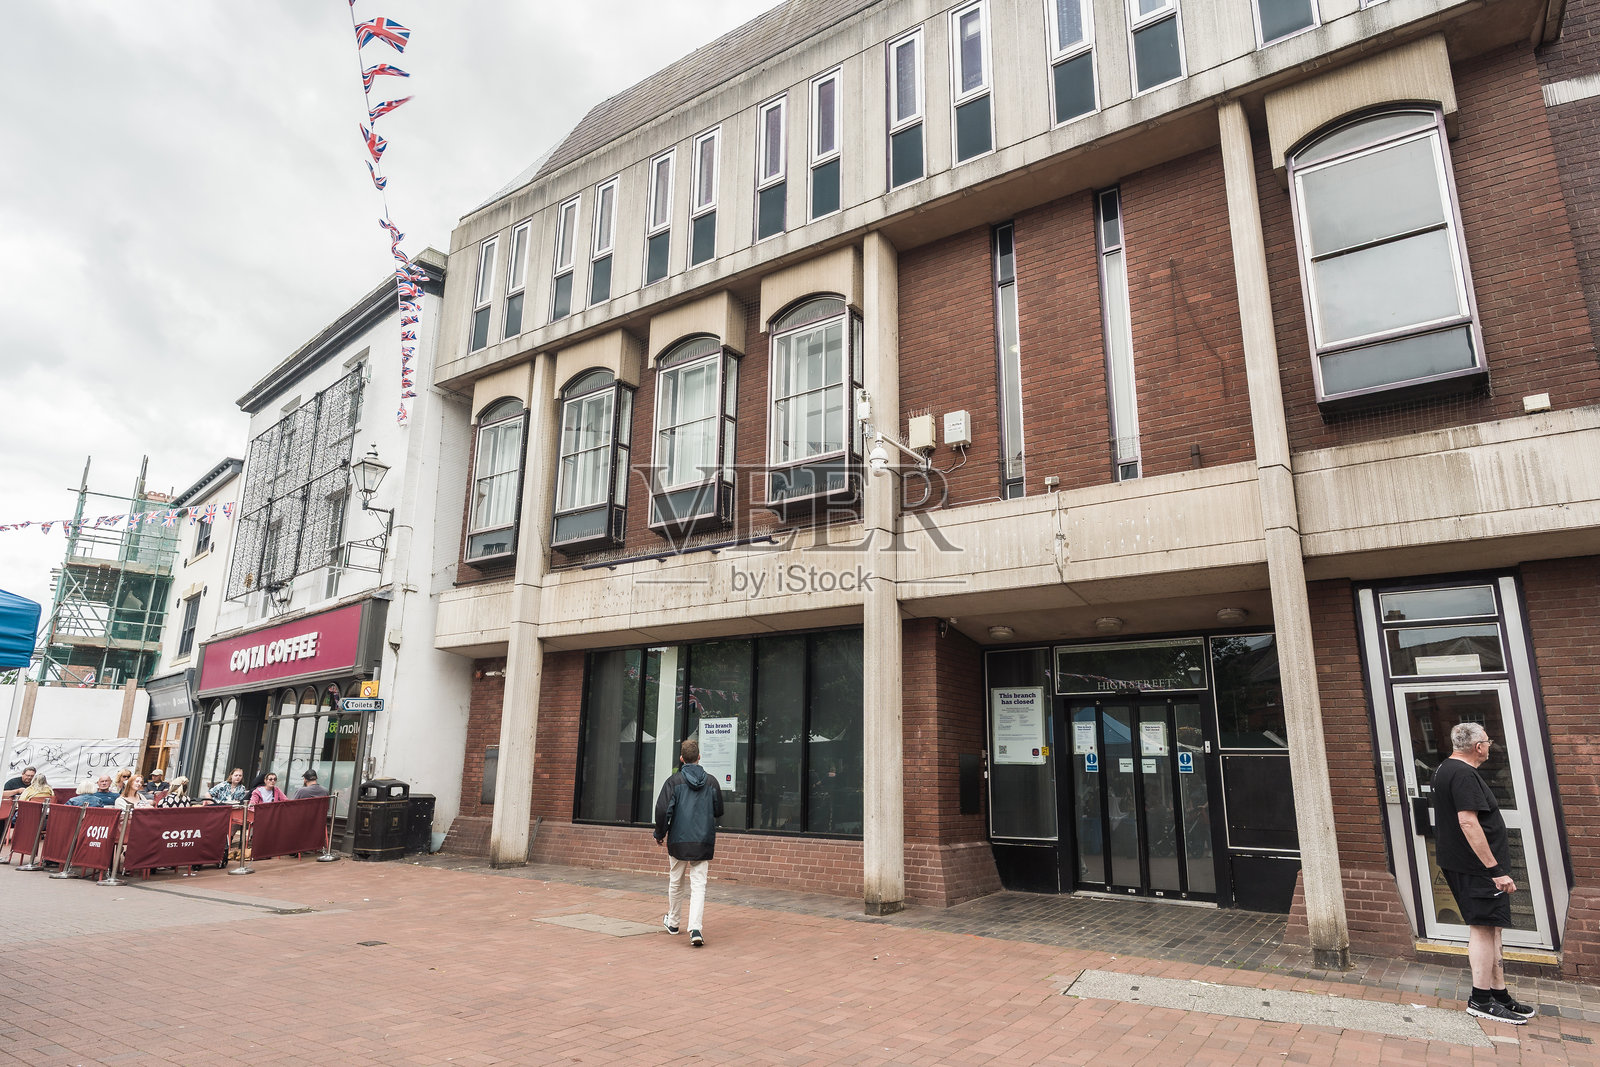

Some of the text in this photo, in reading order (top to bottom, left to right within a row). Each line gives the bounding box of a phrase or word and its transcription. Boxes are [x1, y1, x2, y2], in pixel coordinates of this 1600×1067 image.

[229, 631, 319, 674] COSTA COFFEE
[1128, 678, 1174, 689] STREET
[350, 701, 373, 709] Toilets
[86, 752, 120, 768] UK
[86, 825, 109, 840] COSTA
[161, 829, 202, 840] COSTA
